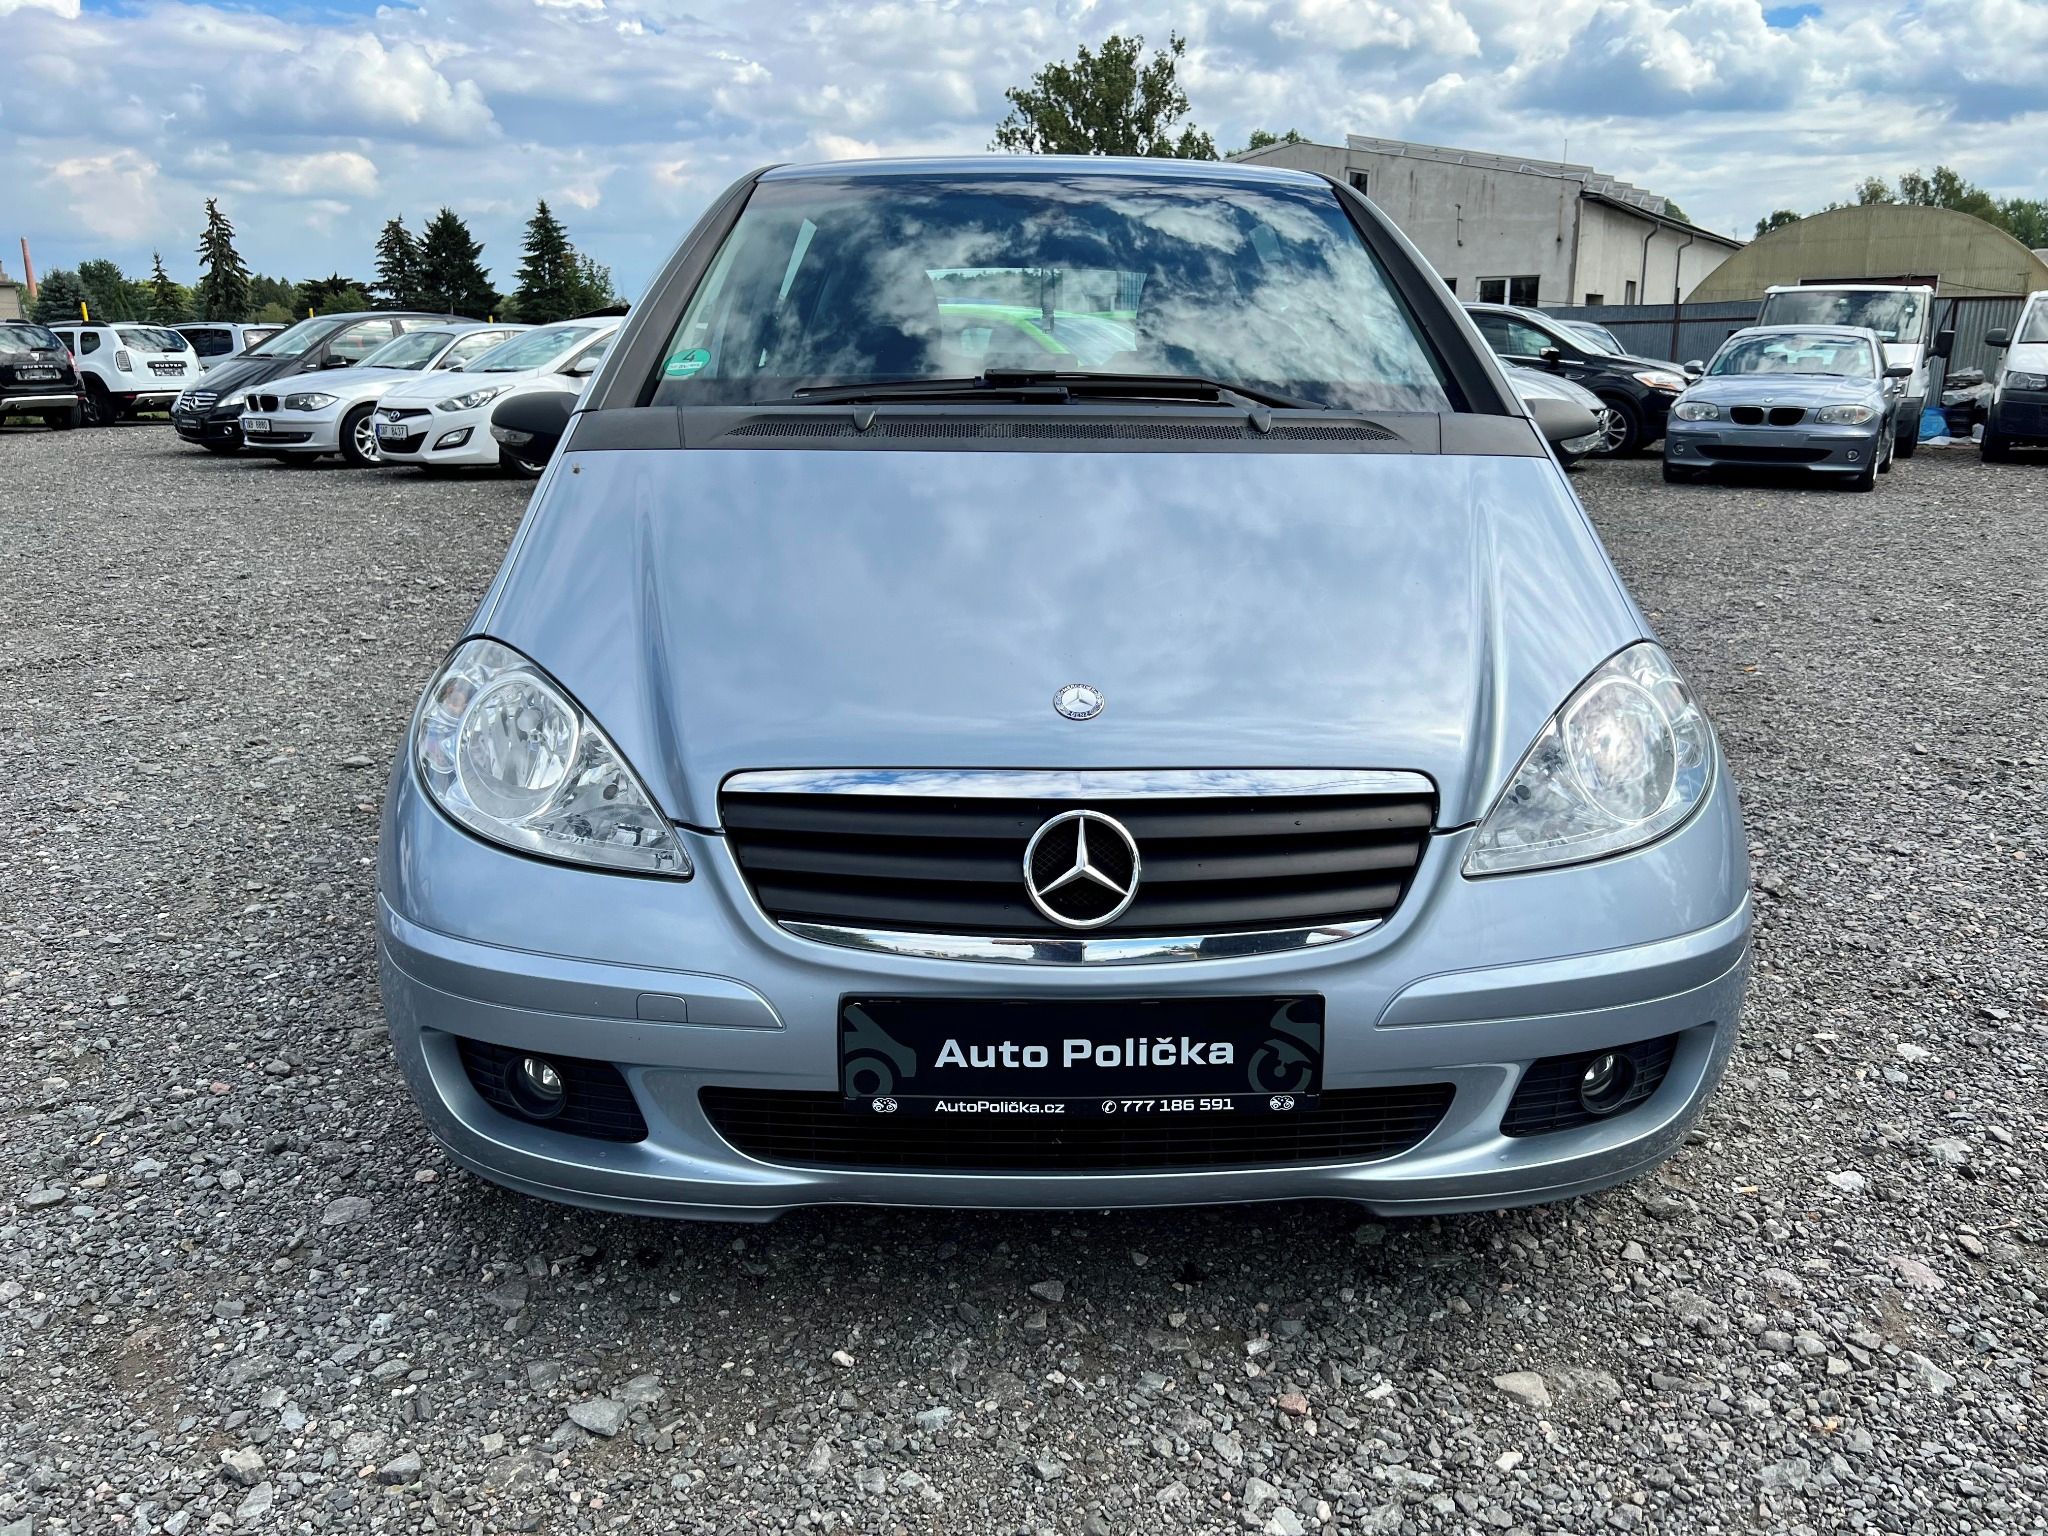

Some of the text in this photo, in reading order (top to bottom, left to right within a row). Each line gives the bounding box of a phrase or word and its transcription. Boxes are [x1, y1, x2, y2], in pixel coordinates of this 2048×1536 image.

[683, 350, 697, 362] 4
[934, 1036, 1235, 1068] Auto Polička
[934, 1099, 1065, 1114] AutoPolička.cz
[1120, 1098, 1235, 1113] 777 186 591
